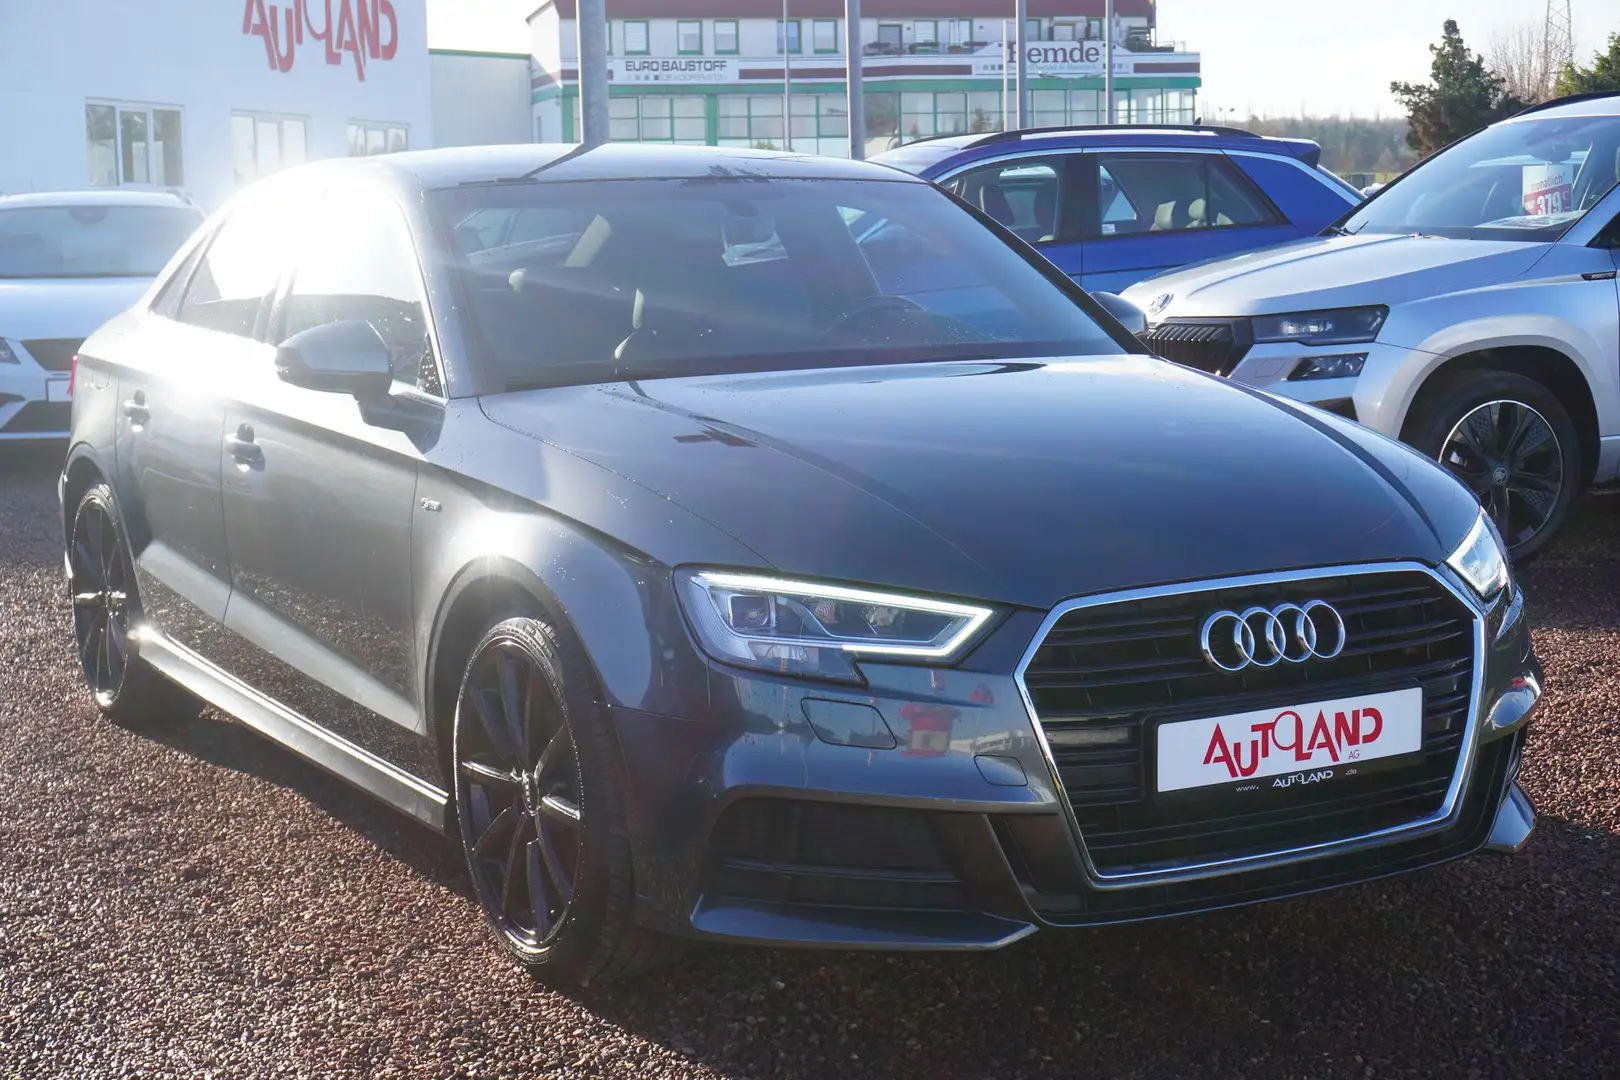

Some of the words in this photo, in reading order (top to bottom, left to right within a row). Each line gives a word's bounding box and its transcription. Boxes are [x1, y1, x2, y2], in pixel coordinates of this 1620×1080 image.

[625, 60, 659, 72] EURO
[661, 60, 727, 72] BAUSTOFF
[1203, 707, 1383, 778] AUTOLAND
[1348, 749, 1361, 760] AG
[1236, 784, 1259, 792] www.
[1272, 770, 1334, 788] AUTOLAND
